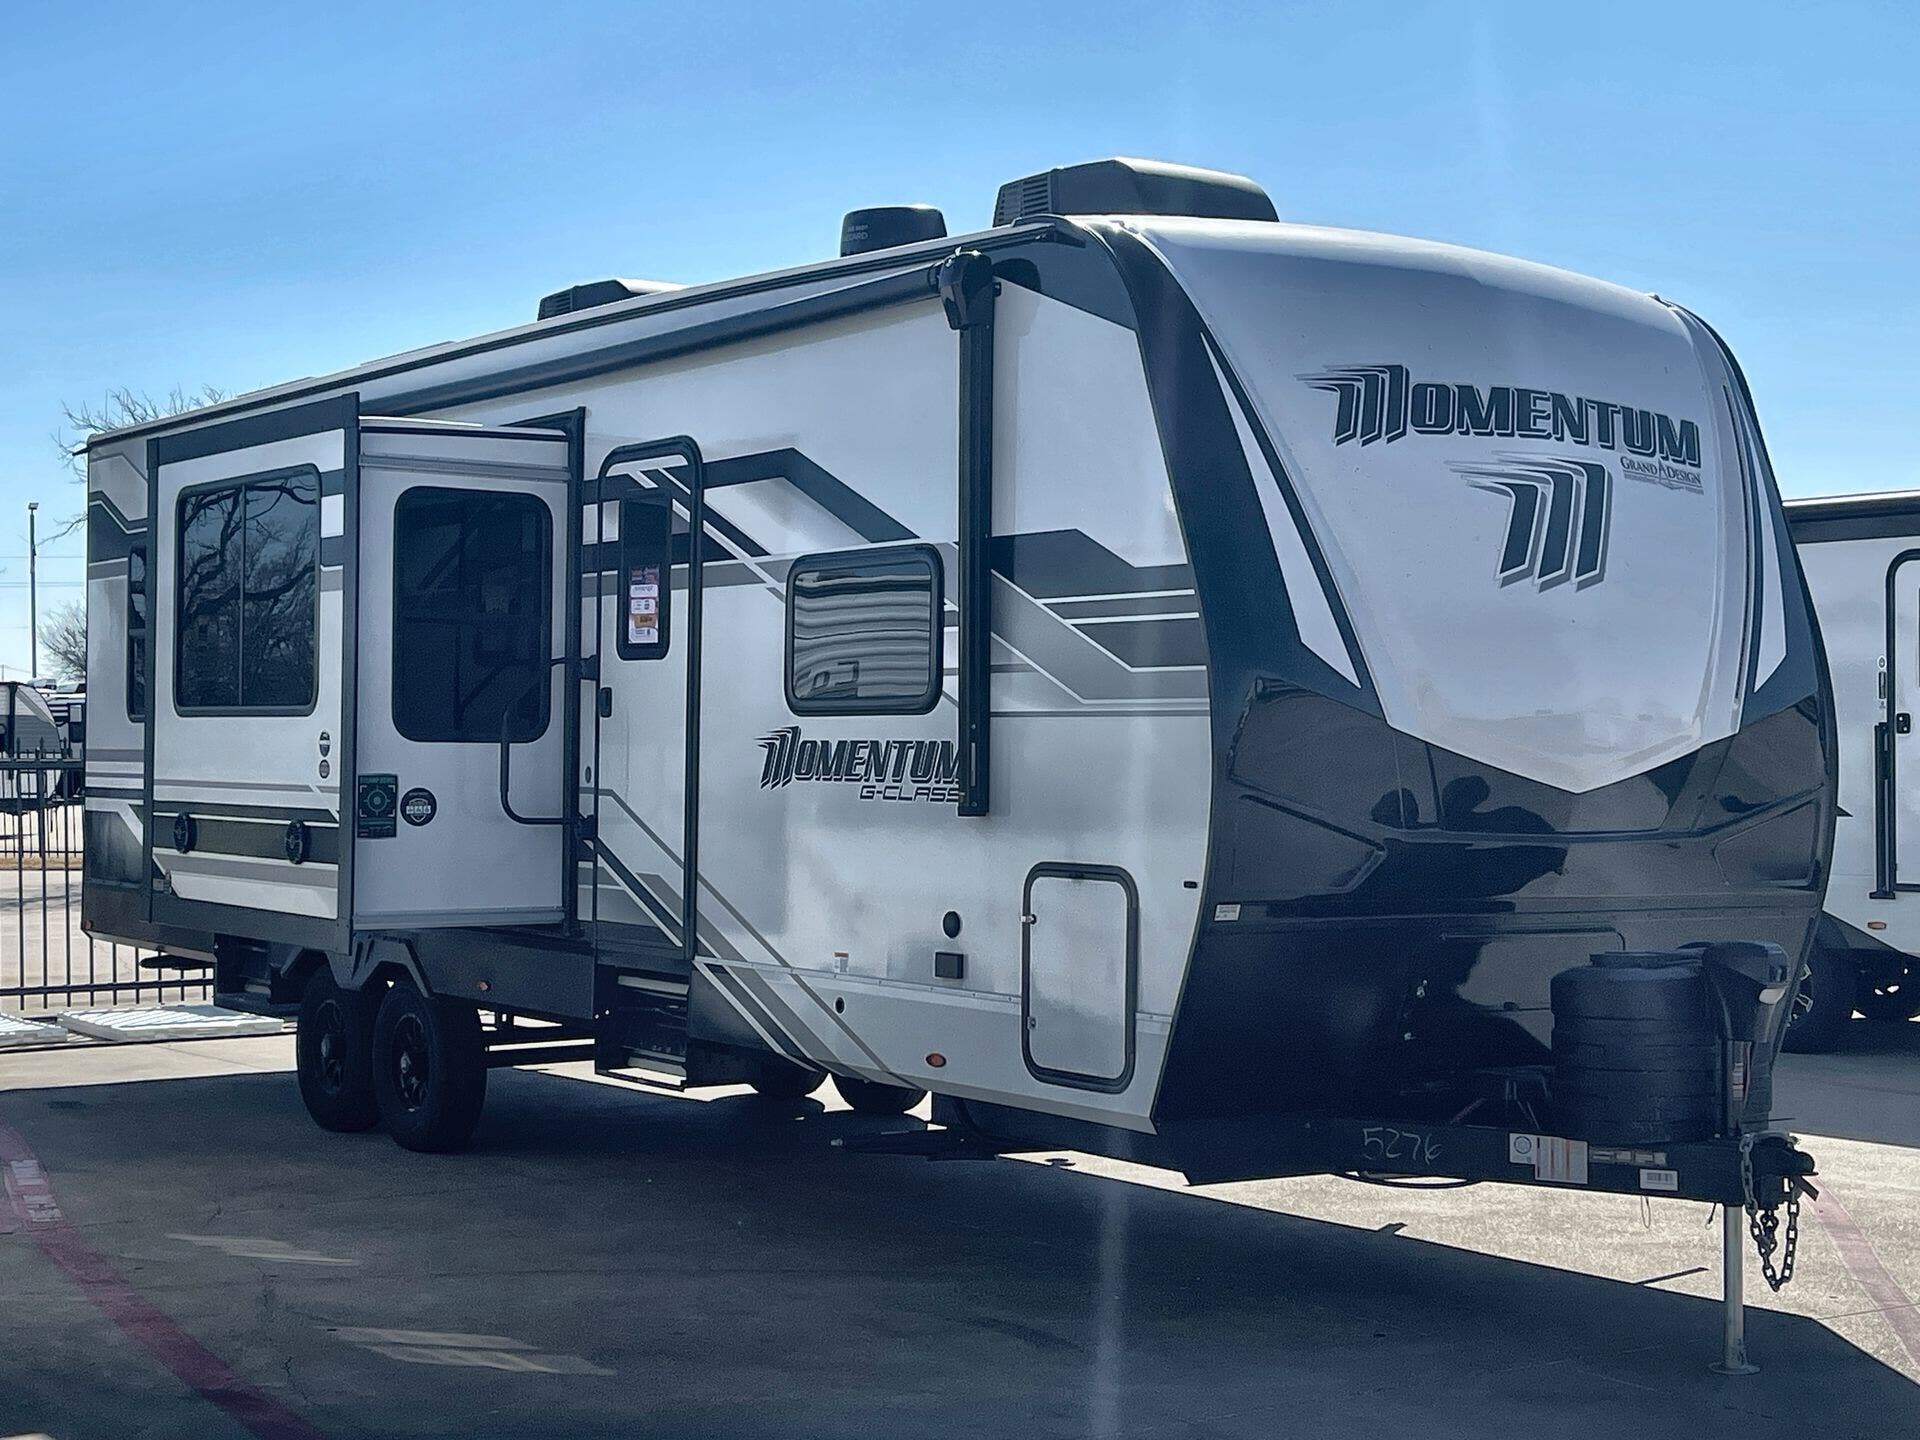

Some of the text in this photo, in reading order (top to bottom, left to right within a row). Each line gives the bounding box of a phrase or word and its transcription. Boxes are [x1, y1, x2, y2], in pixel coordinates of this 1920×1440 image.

[1295, 363, 1702, 468] MOMENTUM
[1620, 456, 1658, 475] GRAND
[1666, 466, 1702, 485] DESIGN
[860, 785, 960, 802] G-CLASS
[1363, 1127, 1442, 1166] 5276
